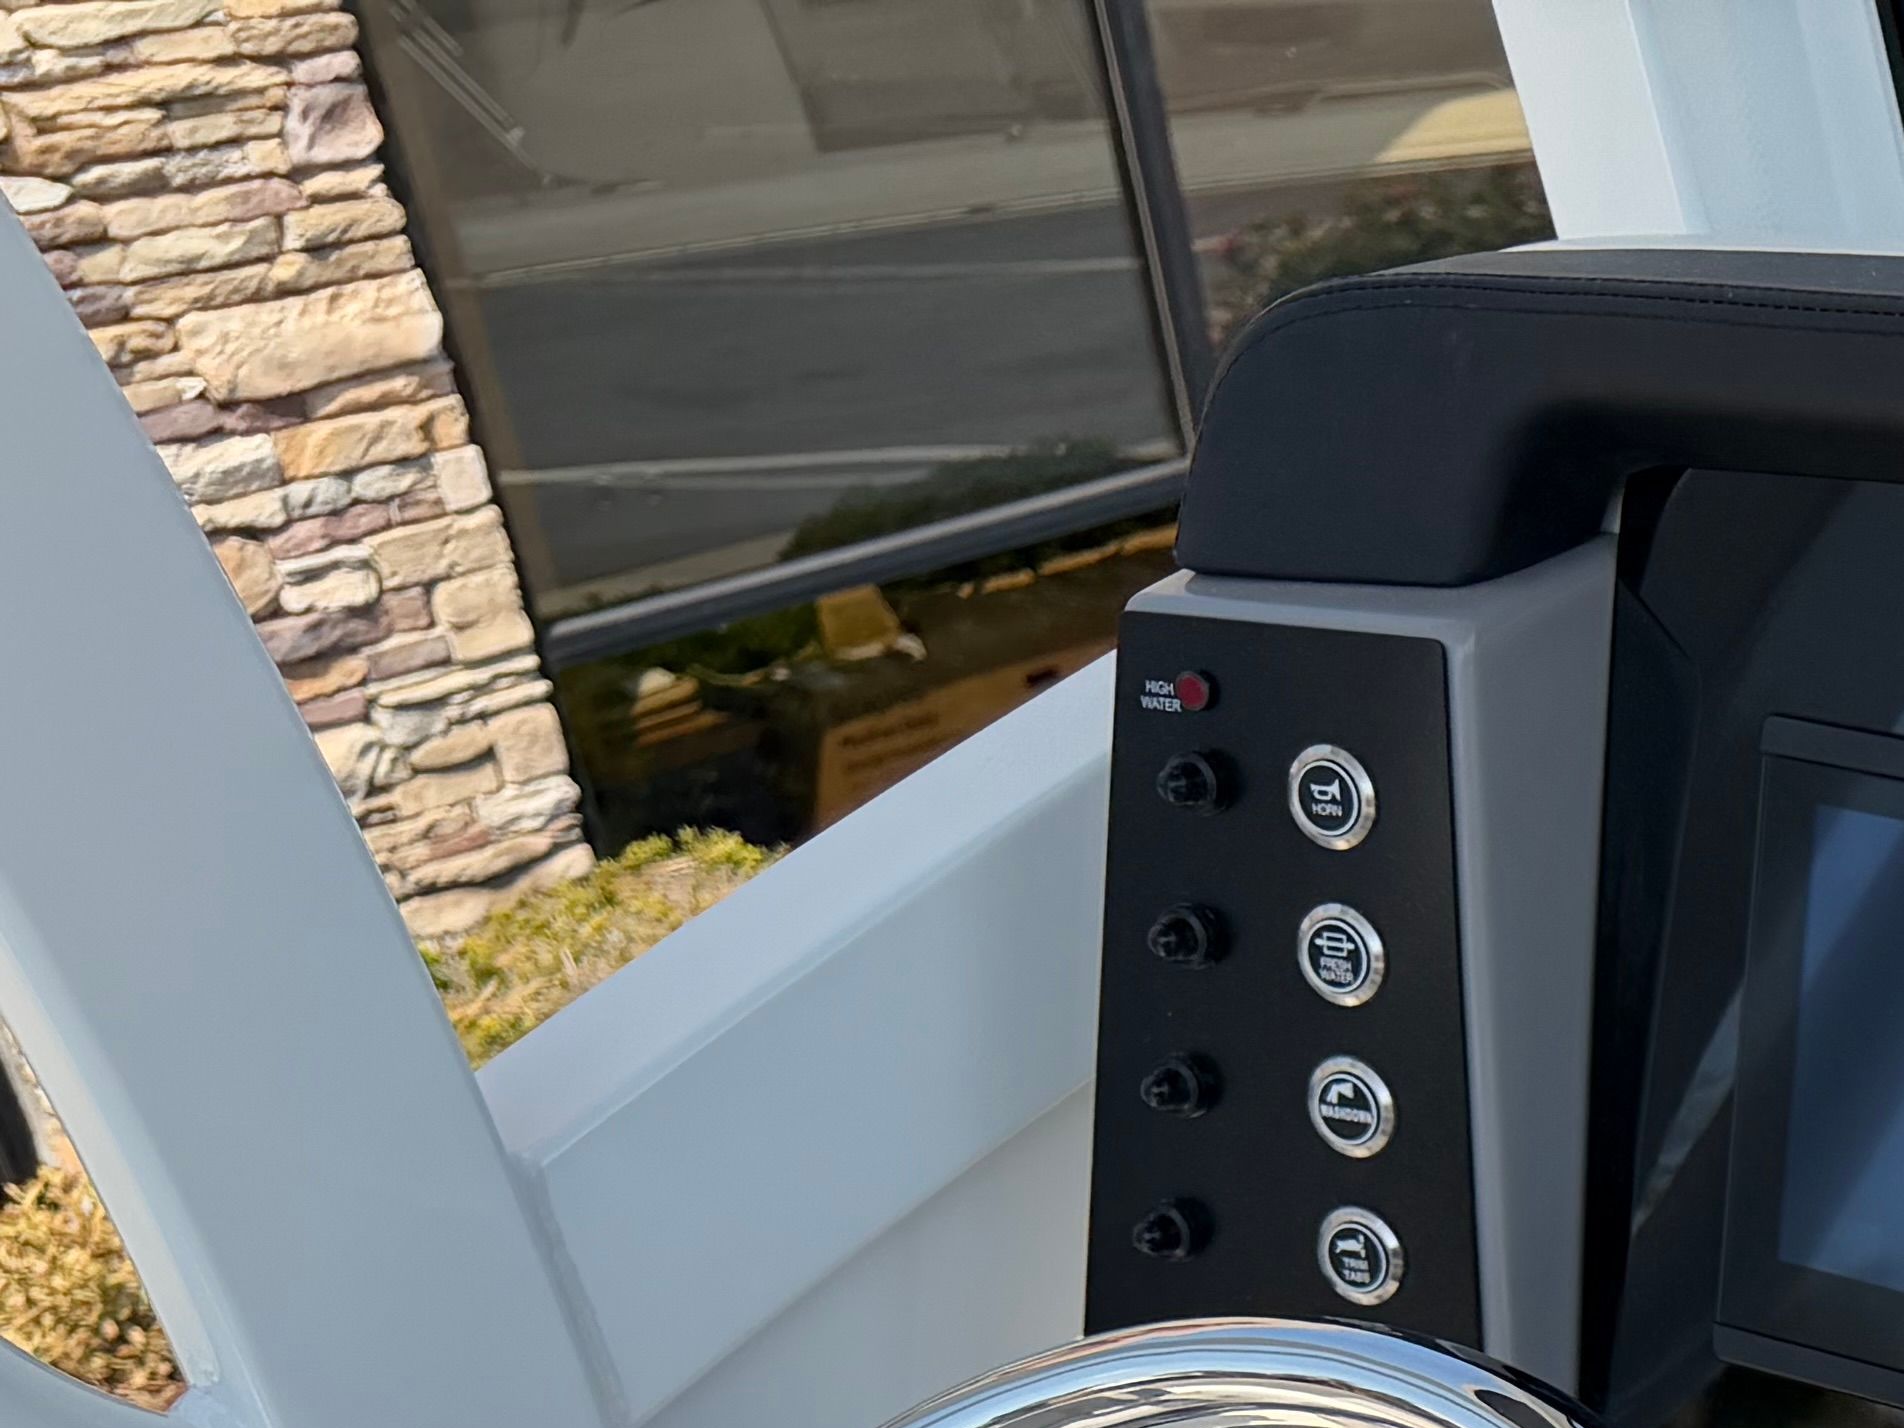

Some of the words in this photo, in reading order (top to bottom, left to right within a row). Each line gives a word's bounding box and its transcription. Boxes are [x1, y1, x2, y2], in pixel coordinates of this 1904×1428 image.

[1145, 679, 1175, 696] HIGH
[1140, 695, 1182, 713] WATER
[1312, 803, 1343, 817] HORN
